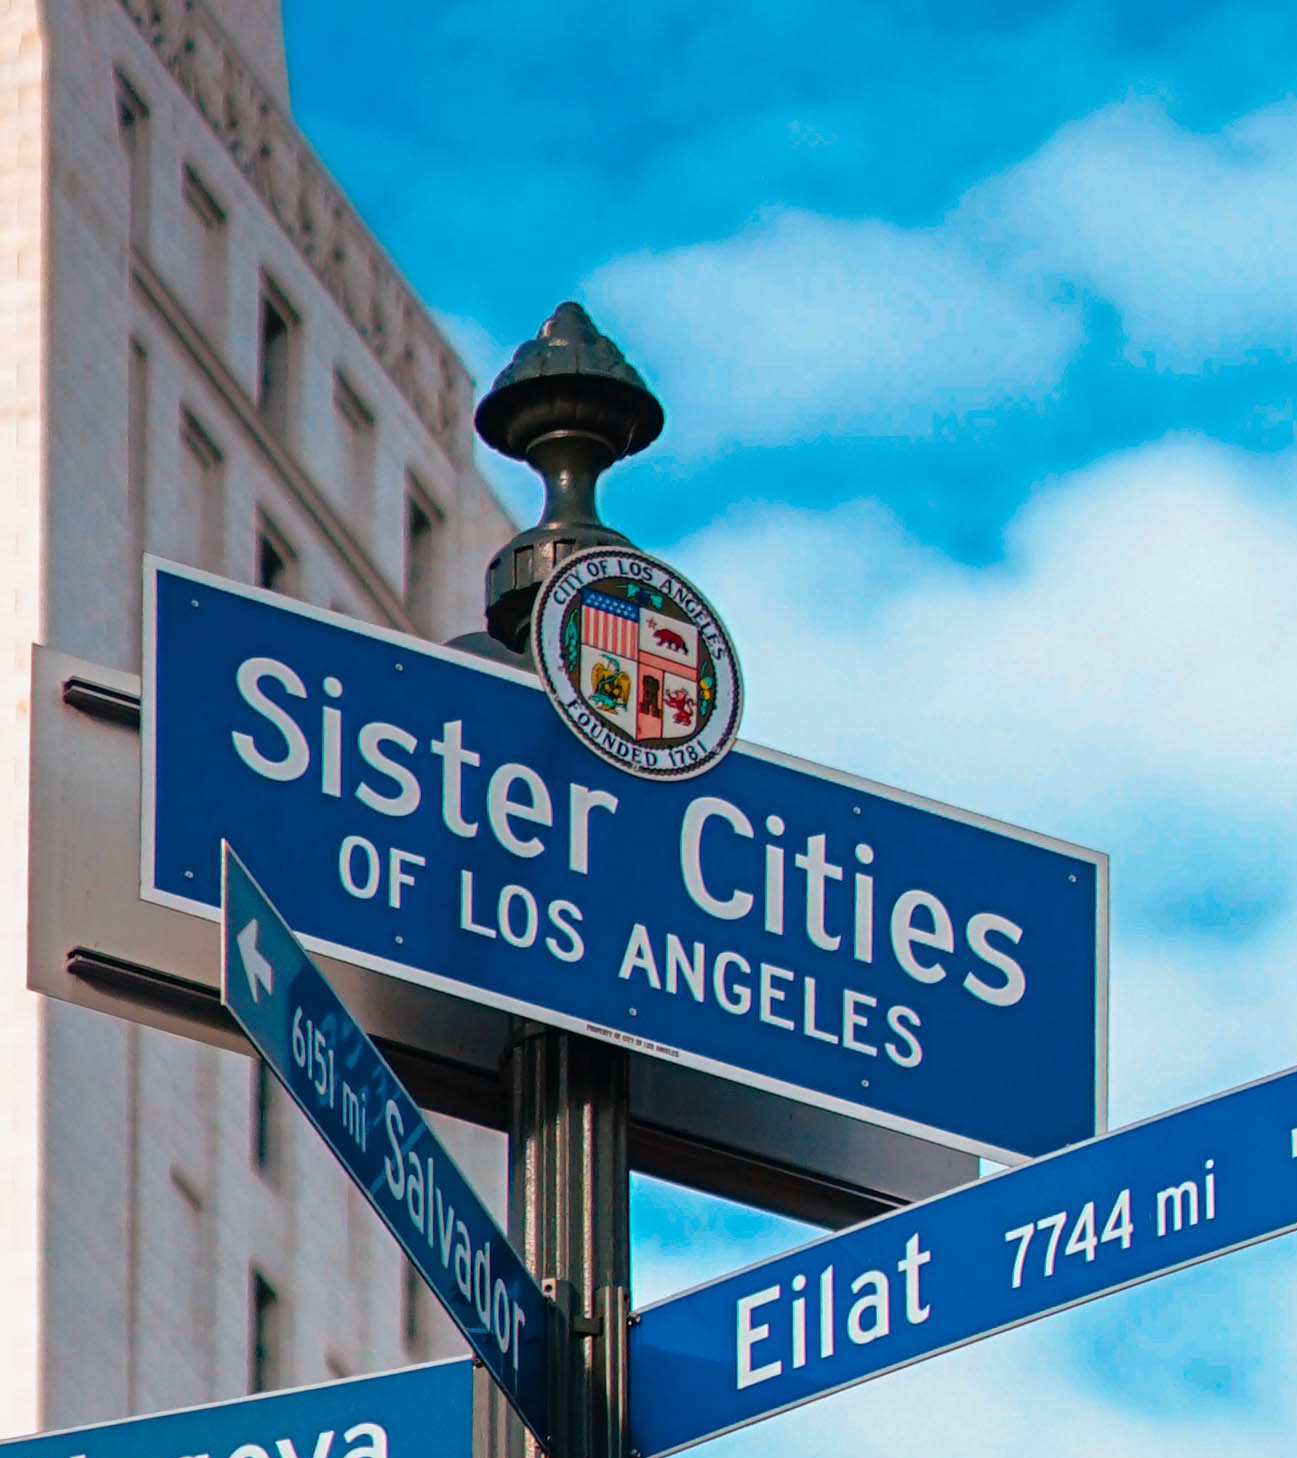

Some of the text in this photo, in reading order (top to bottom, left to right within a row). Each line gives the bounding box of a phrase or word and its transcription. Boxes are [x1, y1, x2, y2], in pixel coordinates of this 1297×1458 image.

[554, 559, 727, 661] CITY OF LOS ANGELES
[232, 657, 1026, 1007] Sister Cities
[566, 698, 708, 768] FOUNDED 1781
[340, 836, 922, 1068] OF LOS ANGELES
[290, 1006, 525, 1369] 6151 mi Salvador
[737, 1160, 1215, 1389] Eilat 7744 mi
